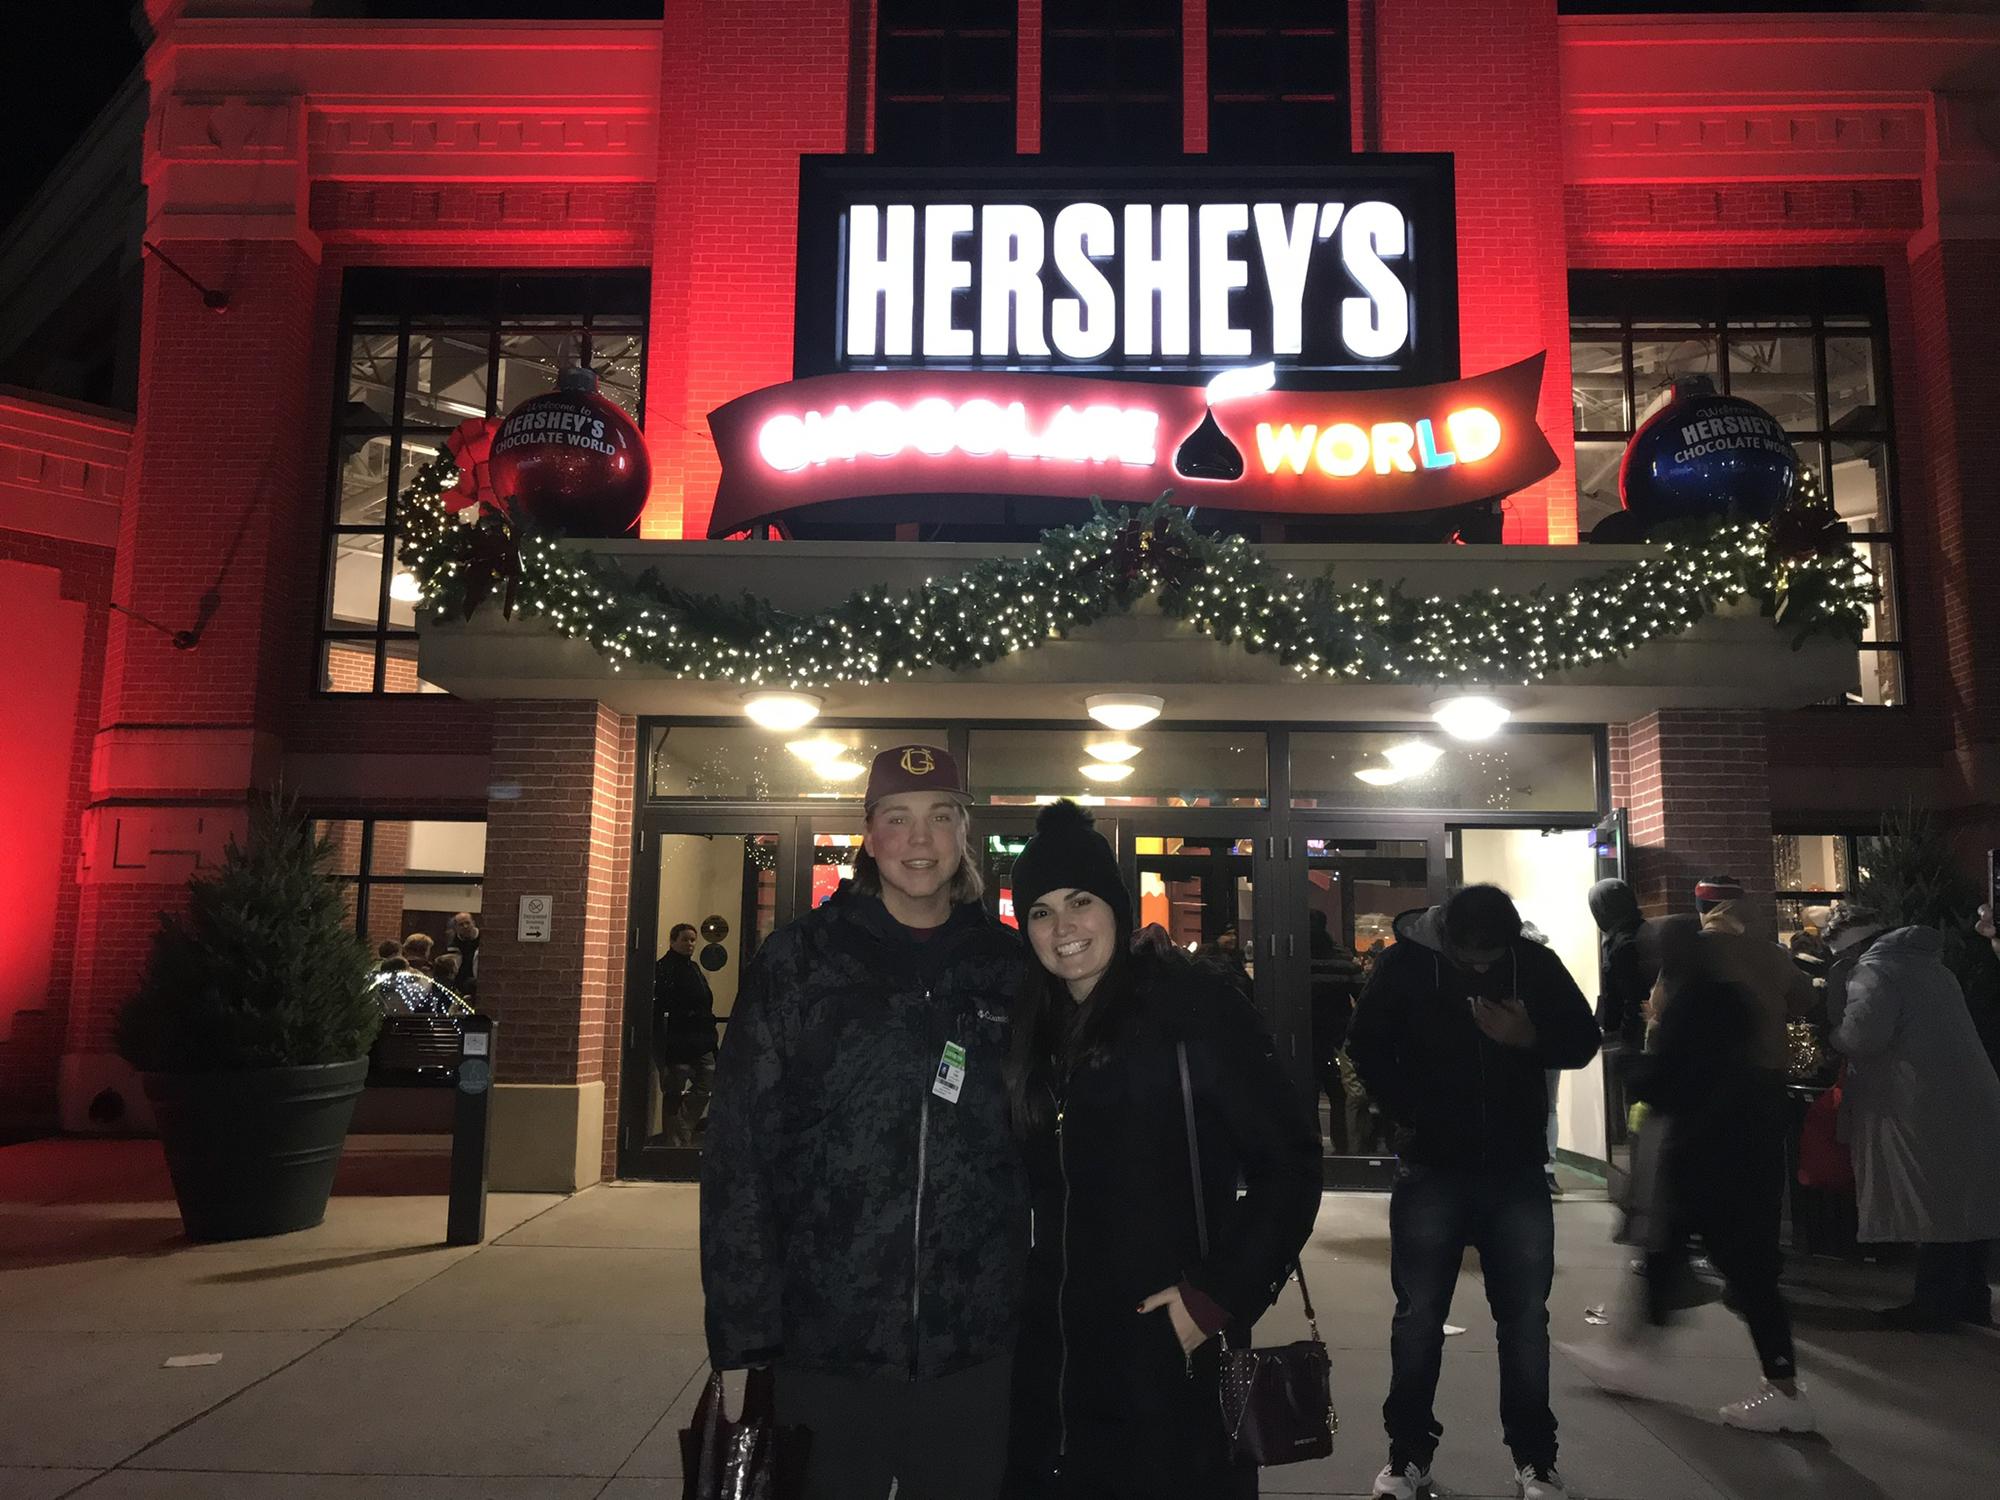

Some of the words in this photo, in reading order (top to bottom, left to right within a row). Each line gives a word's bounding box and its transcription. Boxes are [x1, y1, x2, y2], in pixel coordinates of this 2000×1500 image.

[847, 201, 1409, 358] HERSHEY'S
[580, 405, 591, 415] to
[504, 411, 605, 439] HERSHEY'S
[495, 432, 563, 454] CHOCOLATE
[567, 433, 616, 456] WORLD
[1256, 407, 1501, 477] WORLD
[1674, 436, 1761, 464] CHOCOLATE
